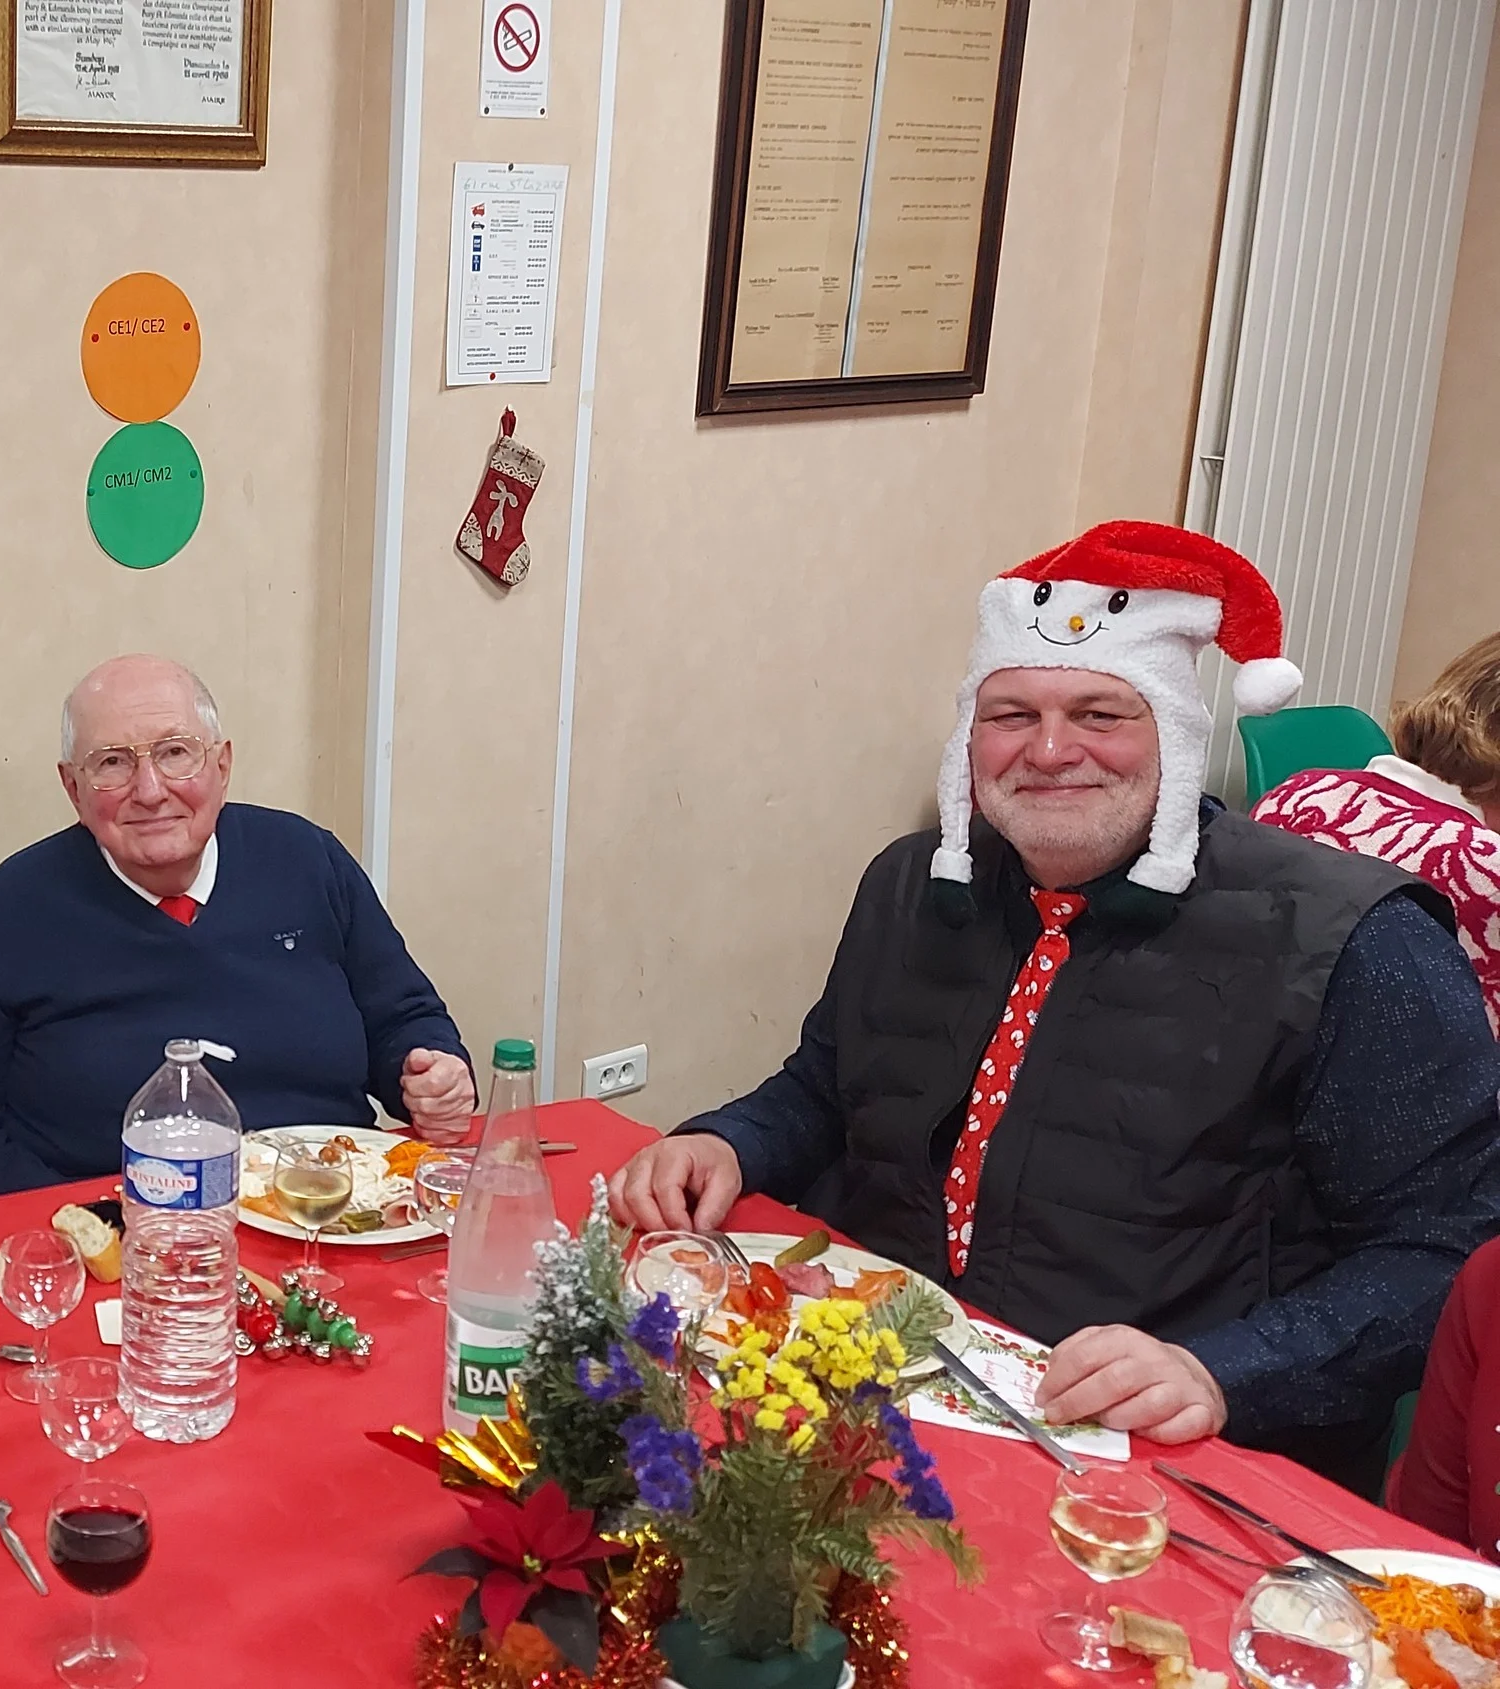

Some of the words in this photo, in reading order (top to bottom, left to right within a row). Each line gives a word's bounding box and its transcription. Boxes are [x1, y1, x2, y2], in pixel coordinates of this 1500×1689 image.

[85, 36, 101, 46] May
[75, 52, 105, 66] Sunday
[88, 64, 106, 76] April
[88, 91, 117, 101] MAYOR
[108, 318, 139, 337] CE1/
[141, 318, 166, 334] CE2
[105, 468, 141, 488] CM1/
[143, 466, 173, 483] CM2
[273, 929, 304, 941] GANT
